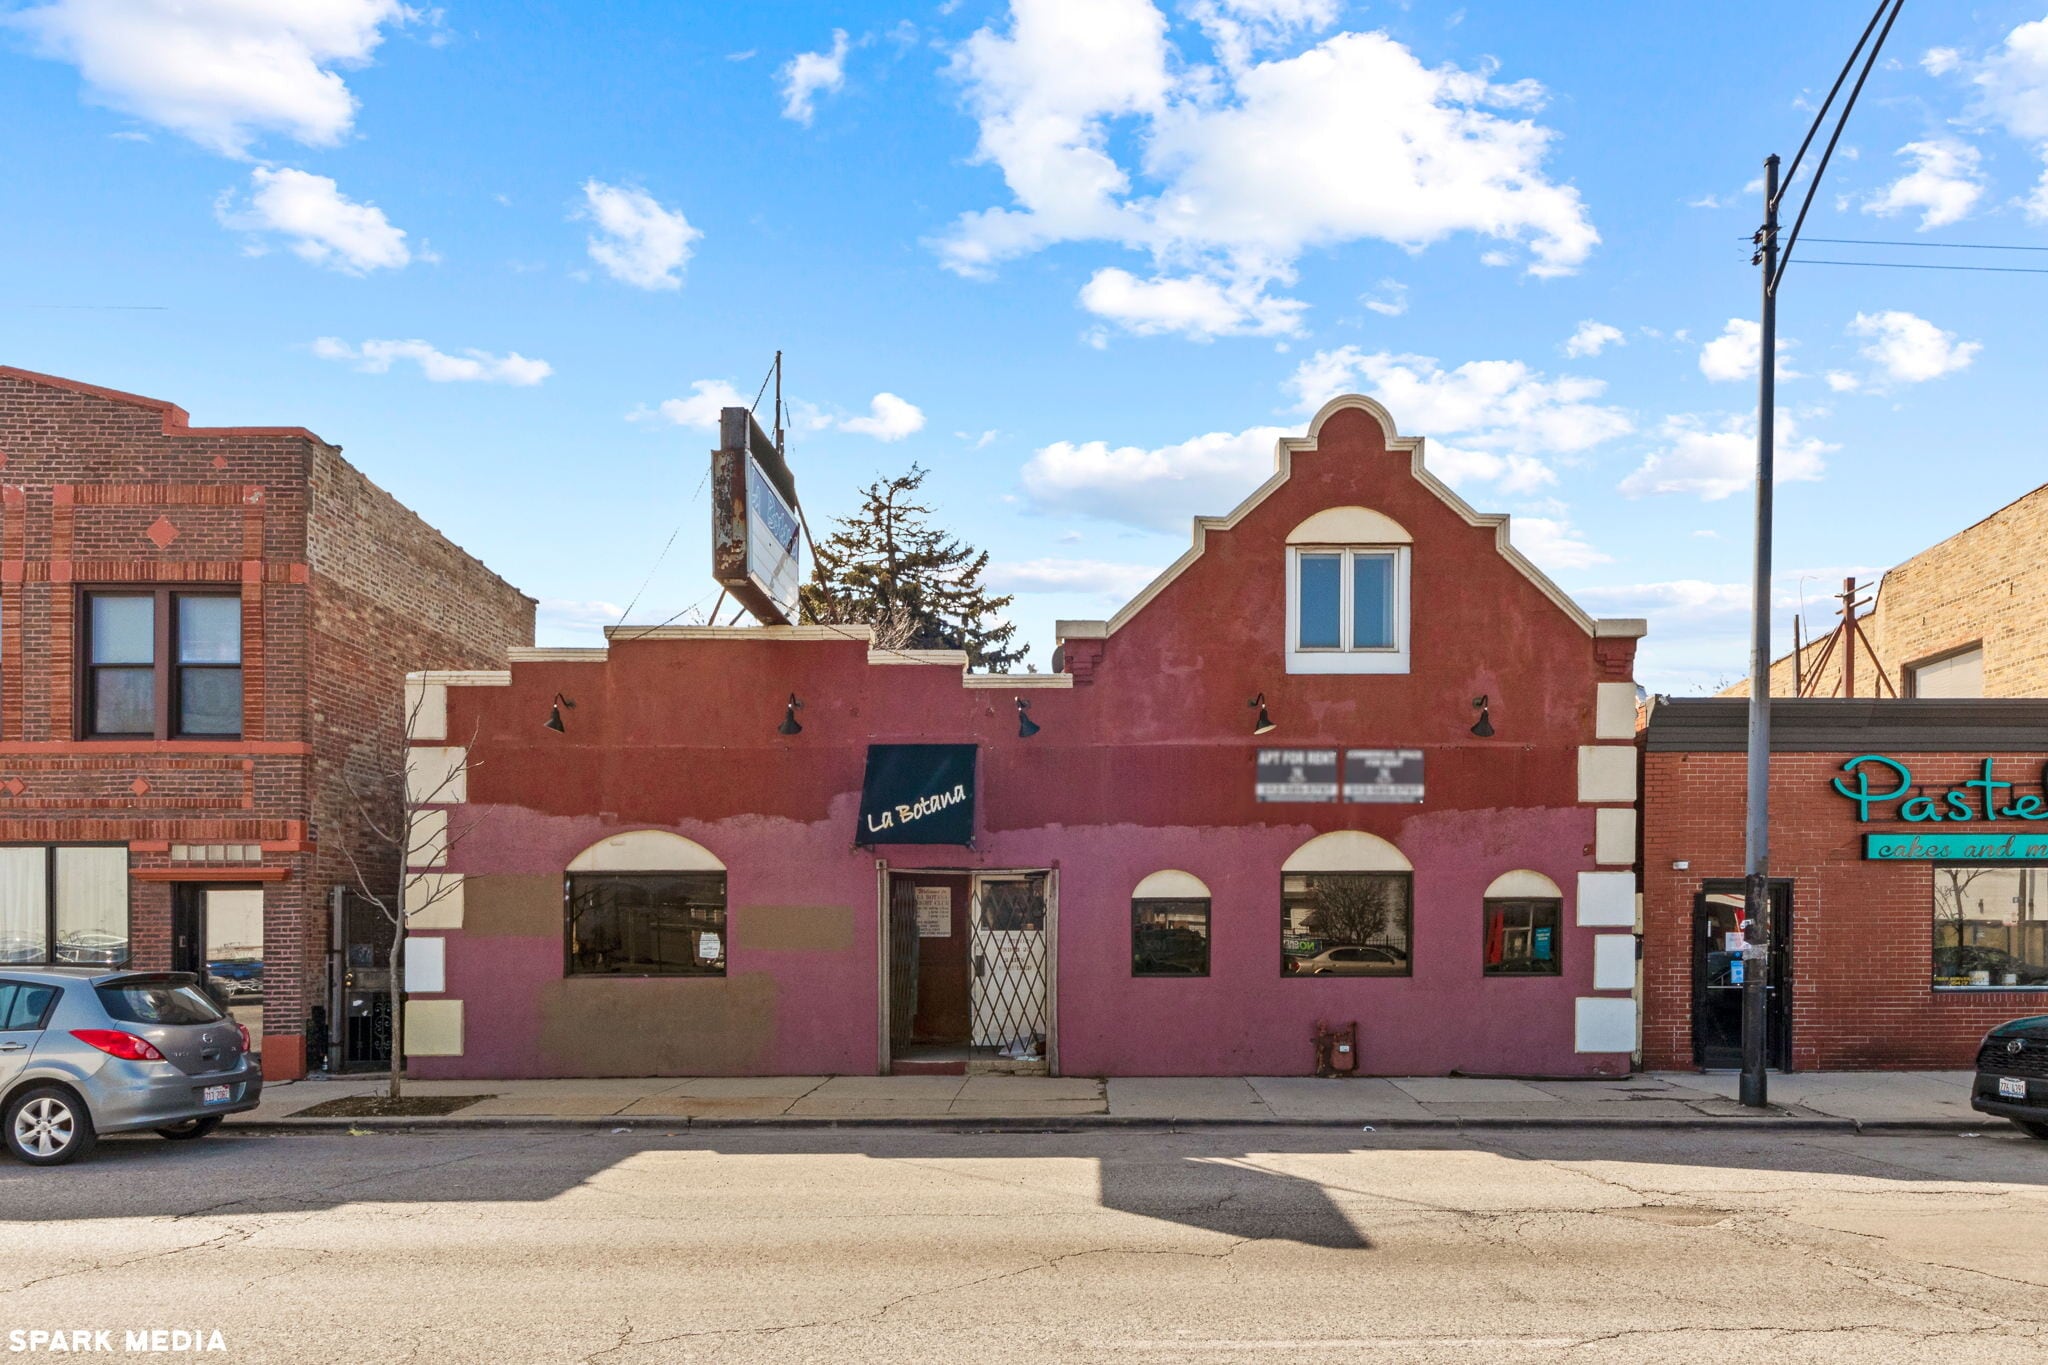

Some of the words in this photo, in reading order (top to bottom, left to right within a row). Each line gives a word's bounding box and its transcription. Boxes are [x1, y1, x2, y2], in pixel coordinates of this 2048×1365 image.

[1259, 751, 1280, 765] APT
[1282, 751, 1305, 765] FOR
[1307, 751, 1336, 765] RENT
[1832, 754, 2048, 822] Paste
[867, 811, 894, 833] La
[895, 784, 967, 824] Botana
[1878, 835, 1951, 858] cakes
[1963, 834, 2017, 858] and
